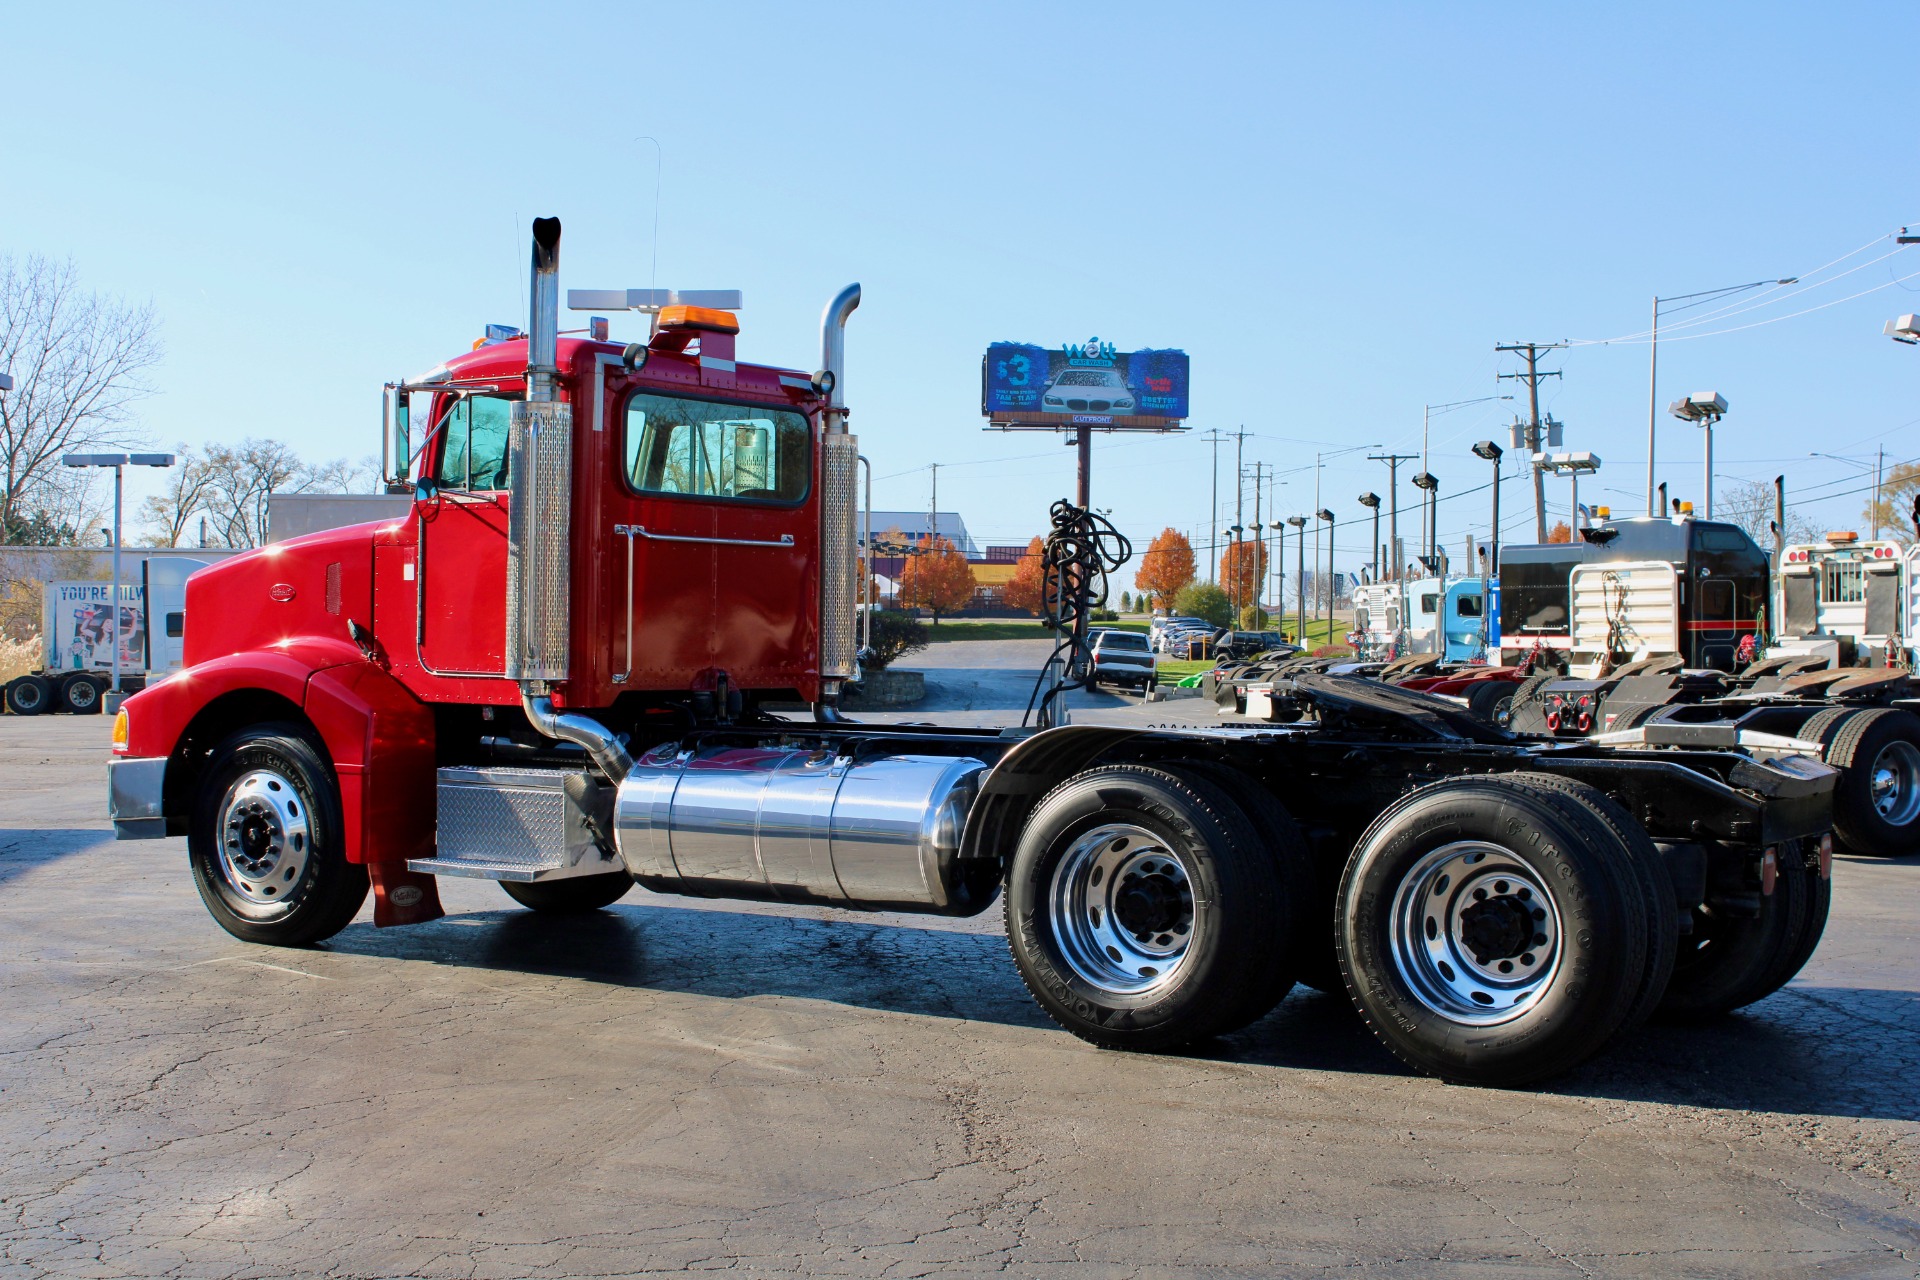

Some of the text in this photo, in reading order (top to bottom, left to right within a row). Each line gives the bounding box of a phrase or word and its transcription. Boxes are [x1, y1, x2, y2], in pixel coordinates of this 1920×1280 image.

[997, 354, 1031, 386] $3
[61, 587, 108, 600] YOU'RE
[251, 753, 306, 792] MICHELIN
[1506, 816, 1593, 1001] Firestone
[1020, 920, 1100, 1025] YOKOHAMA
